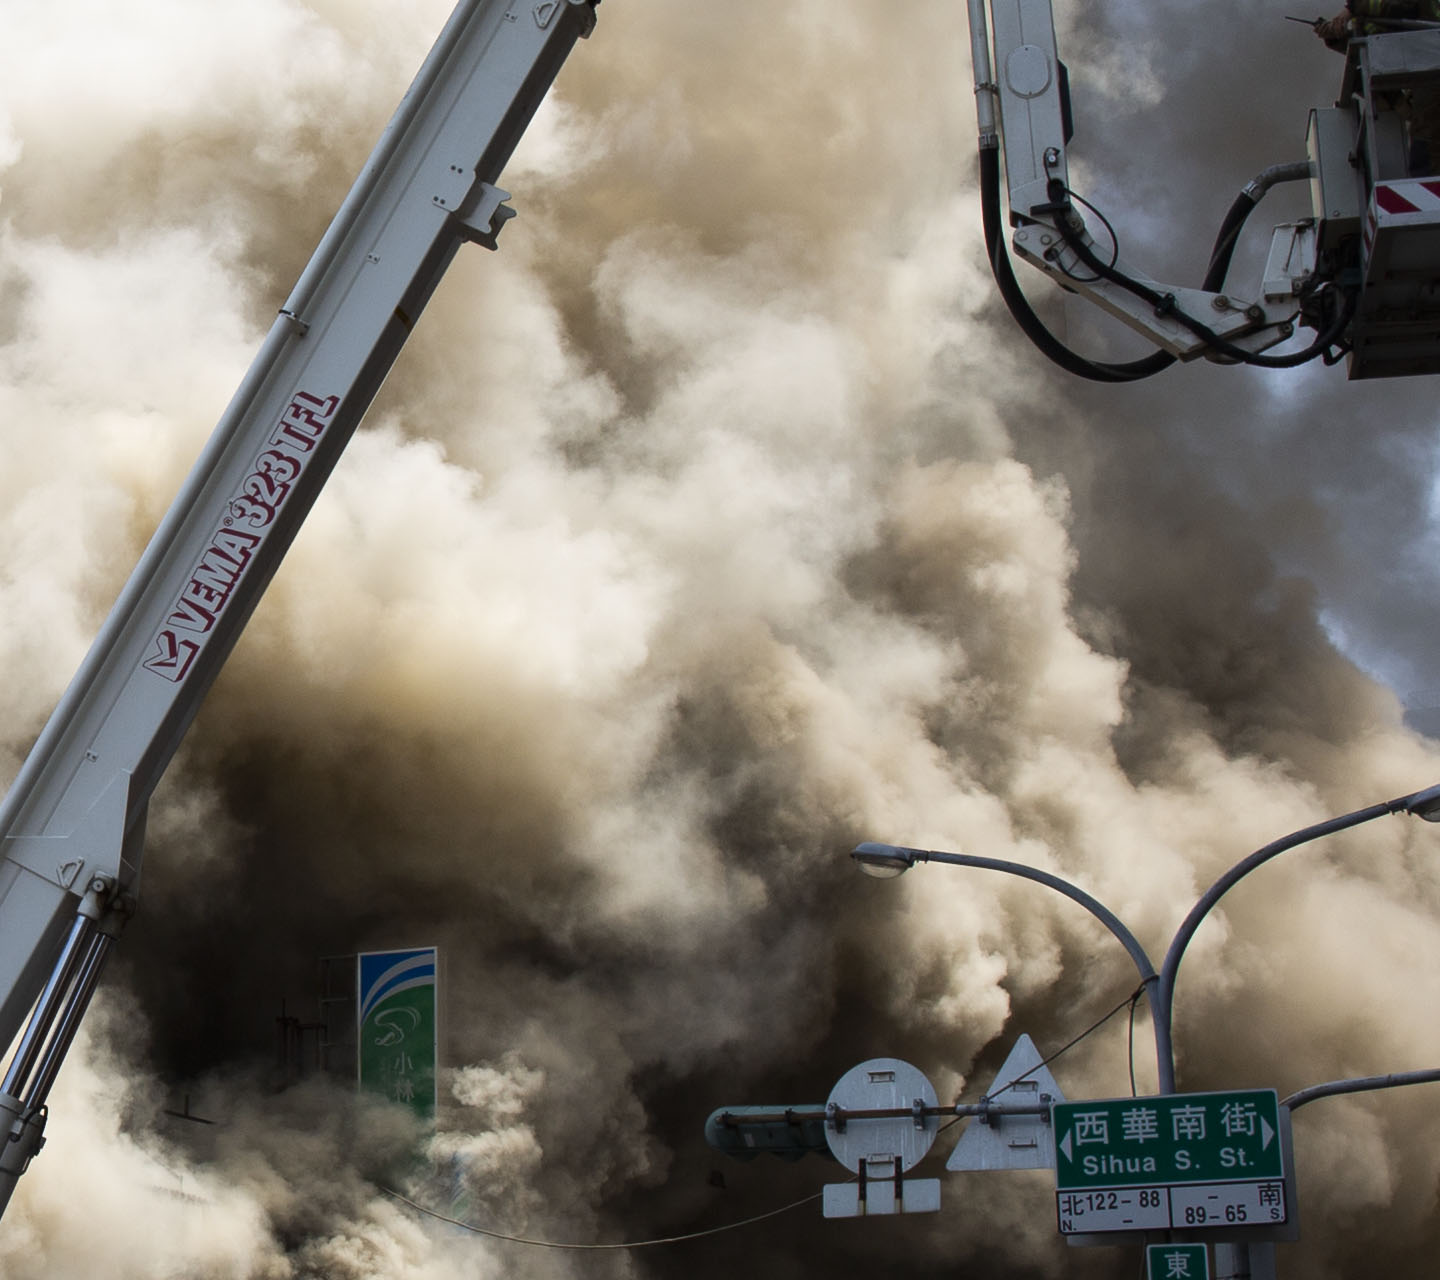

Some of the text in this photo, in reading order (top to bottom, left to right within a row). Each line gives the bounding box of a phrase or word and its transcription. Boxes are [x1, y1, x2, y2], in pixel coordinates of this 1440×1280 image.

[231, 450, 301, 528] 323
[271, 391, 340, 453] TFL
[1072, 1102, 1257, 1147] 西華南街
[1083, 1147, 1256, 1176] Sihua S. St.
[1062, 1195, 1085, 1217] 北
[1258, 1183, 1282, 1207] 南
[1164, 1250, 1192, 1279] 東
